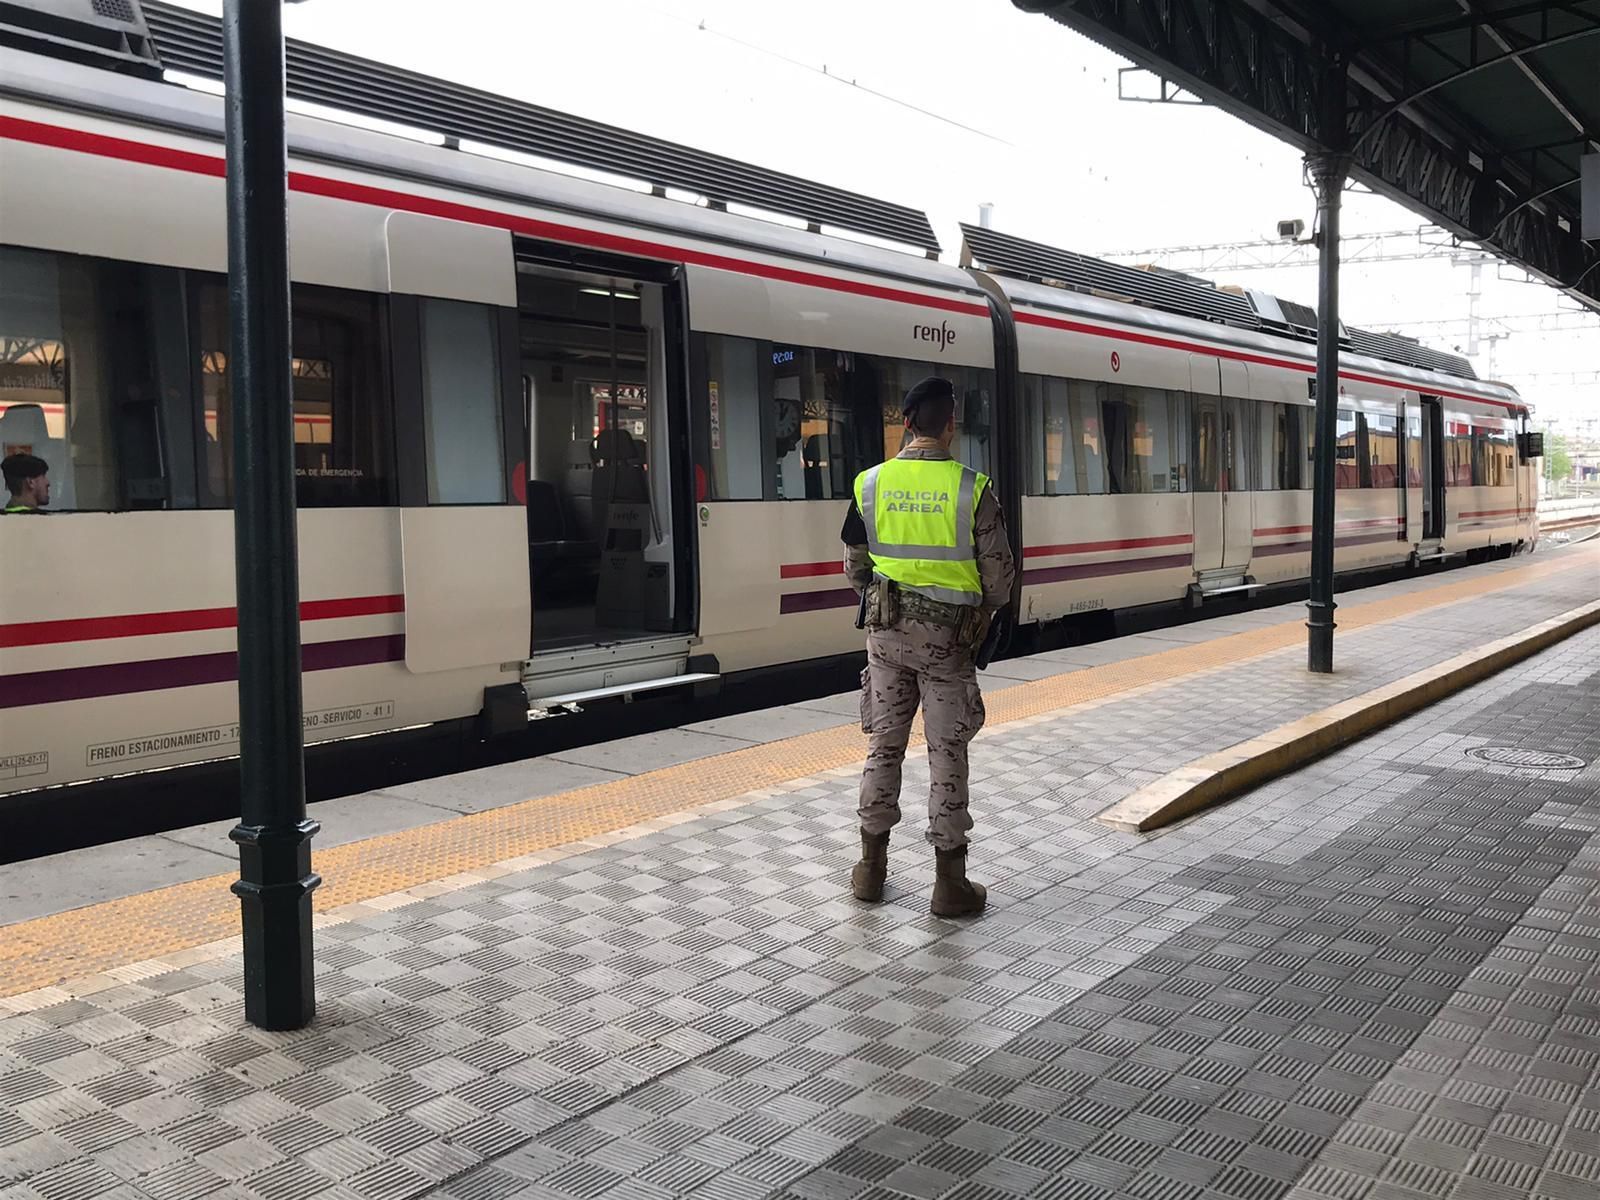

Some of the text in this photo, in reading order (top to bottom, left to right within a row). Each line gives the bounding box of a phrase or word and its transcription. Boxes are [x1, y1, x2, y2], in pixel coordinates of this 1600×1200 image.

[913, 319, 956, 352] renfe
[882, 489, 950, 502] POLICÍA
[886, 500, 944, 514] AÉREA
[323, 708, 362, 724] SERVICIO
[373, 705, 384, 717] 41
[90, 744, 126, 761] FRENO
[128, 729, 220, 755] ESTACIONAMIENTO
